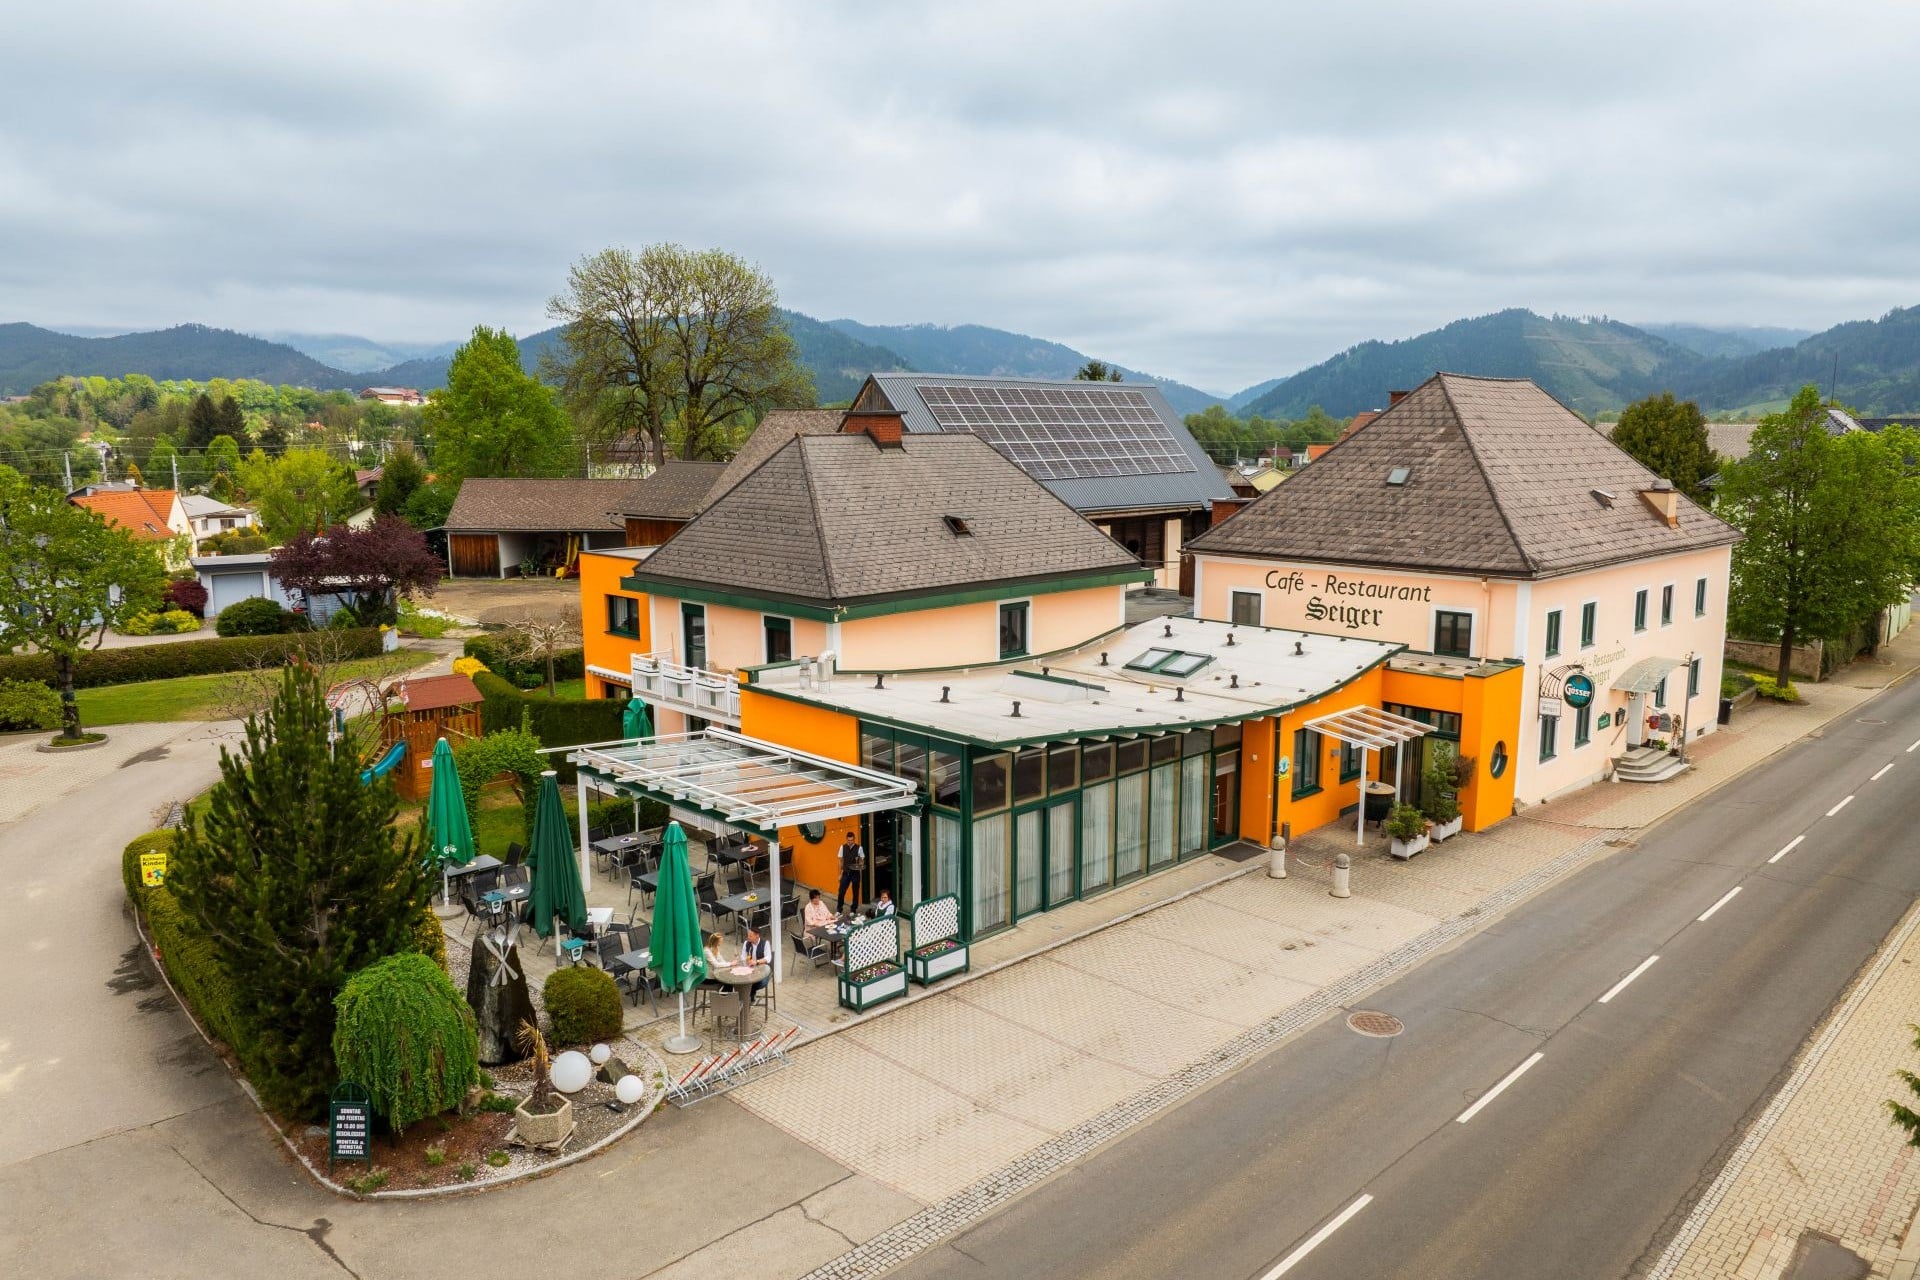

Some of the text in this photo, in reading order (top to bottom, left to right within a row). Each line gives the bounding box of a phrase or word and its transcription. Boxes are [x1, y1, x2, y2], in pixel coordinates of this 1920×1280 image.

[1265, 570, 1304, 595] Café
[1324, 574, 1432, 602] Restaurant
[1305, 596, 1383, 629] Seiger
